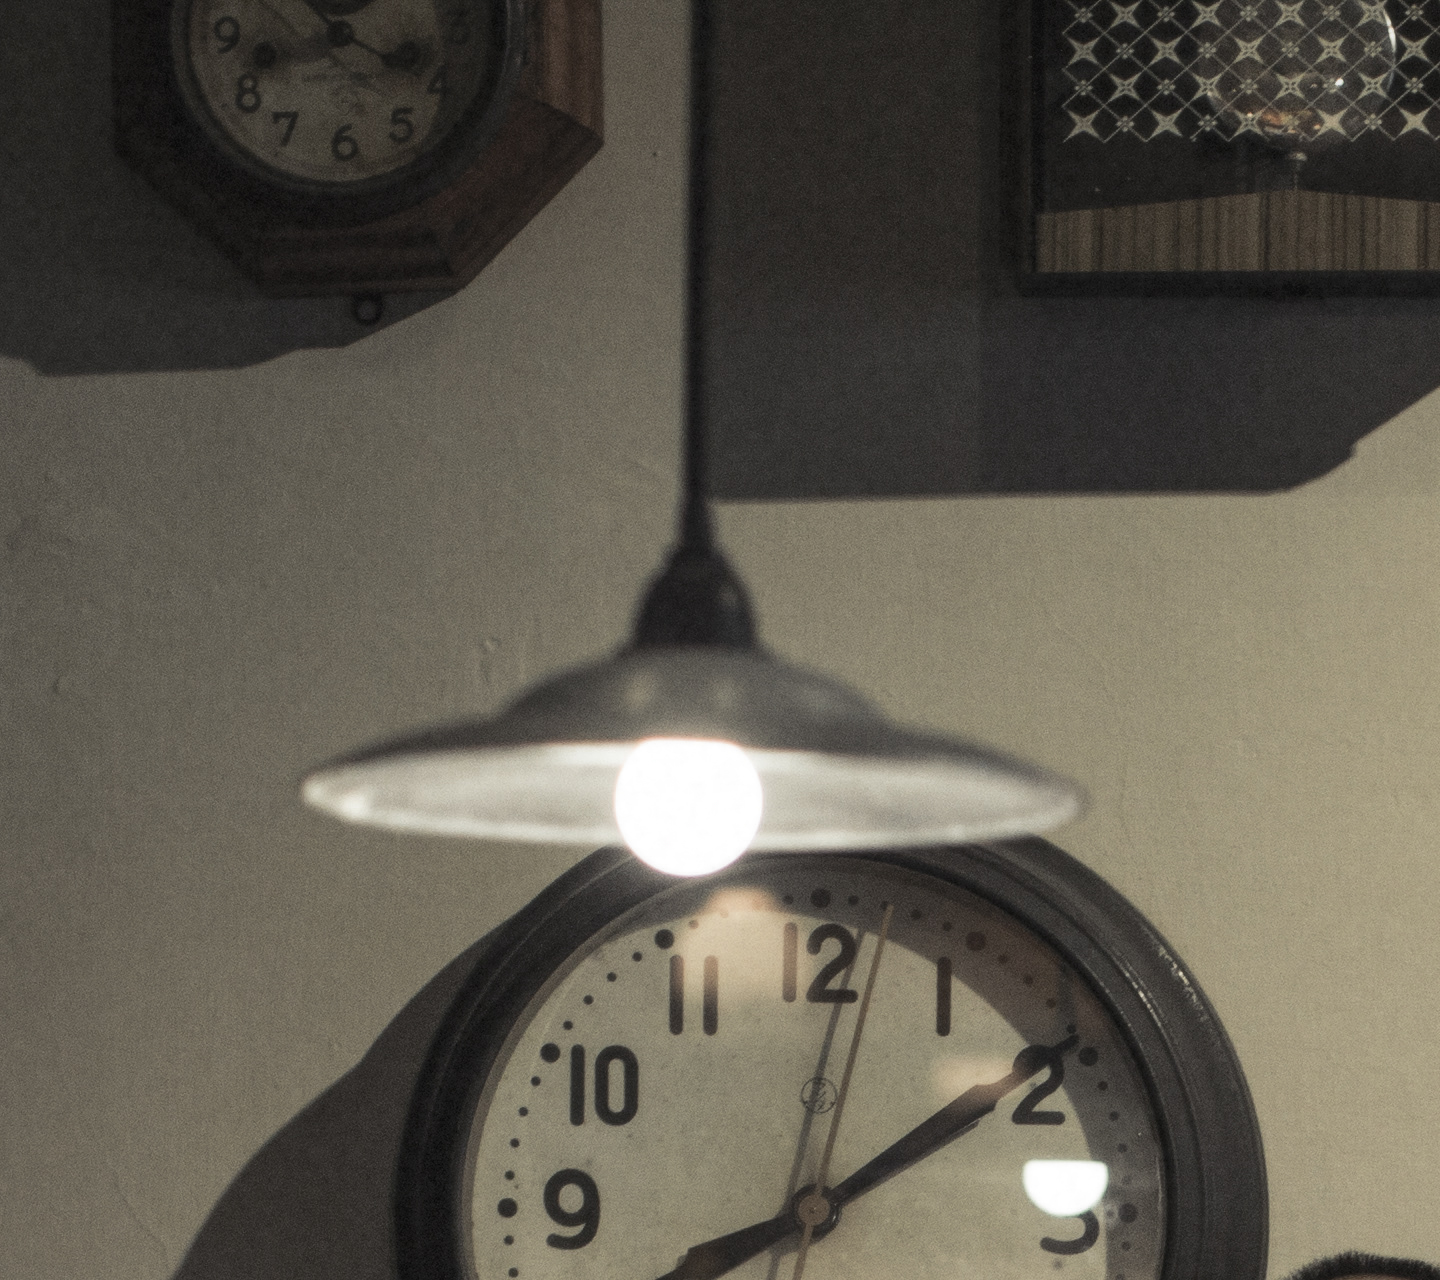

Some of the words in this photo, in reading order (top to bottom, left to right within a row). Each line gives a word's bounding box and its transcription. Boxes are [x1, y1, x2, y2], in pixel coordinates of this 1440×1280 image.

[214, 16, 240, 53] 9
[235, 72, 261, 113] 8
[427, 65, 449, 97] 4
[272, 111, 299, 146] 7
[331, 124, 358, 161] 6
[388, 107, 414, 143] 5
[782, 923, 859, 1004] 12
[669, 954, 719, 1036] 11
[936, 956, 953, 1038] 1
[569, 1043, 640, 1127] 10
[1011, 1043, 1067, 1126] 2
[543, 1167, 601, 1251] 9
